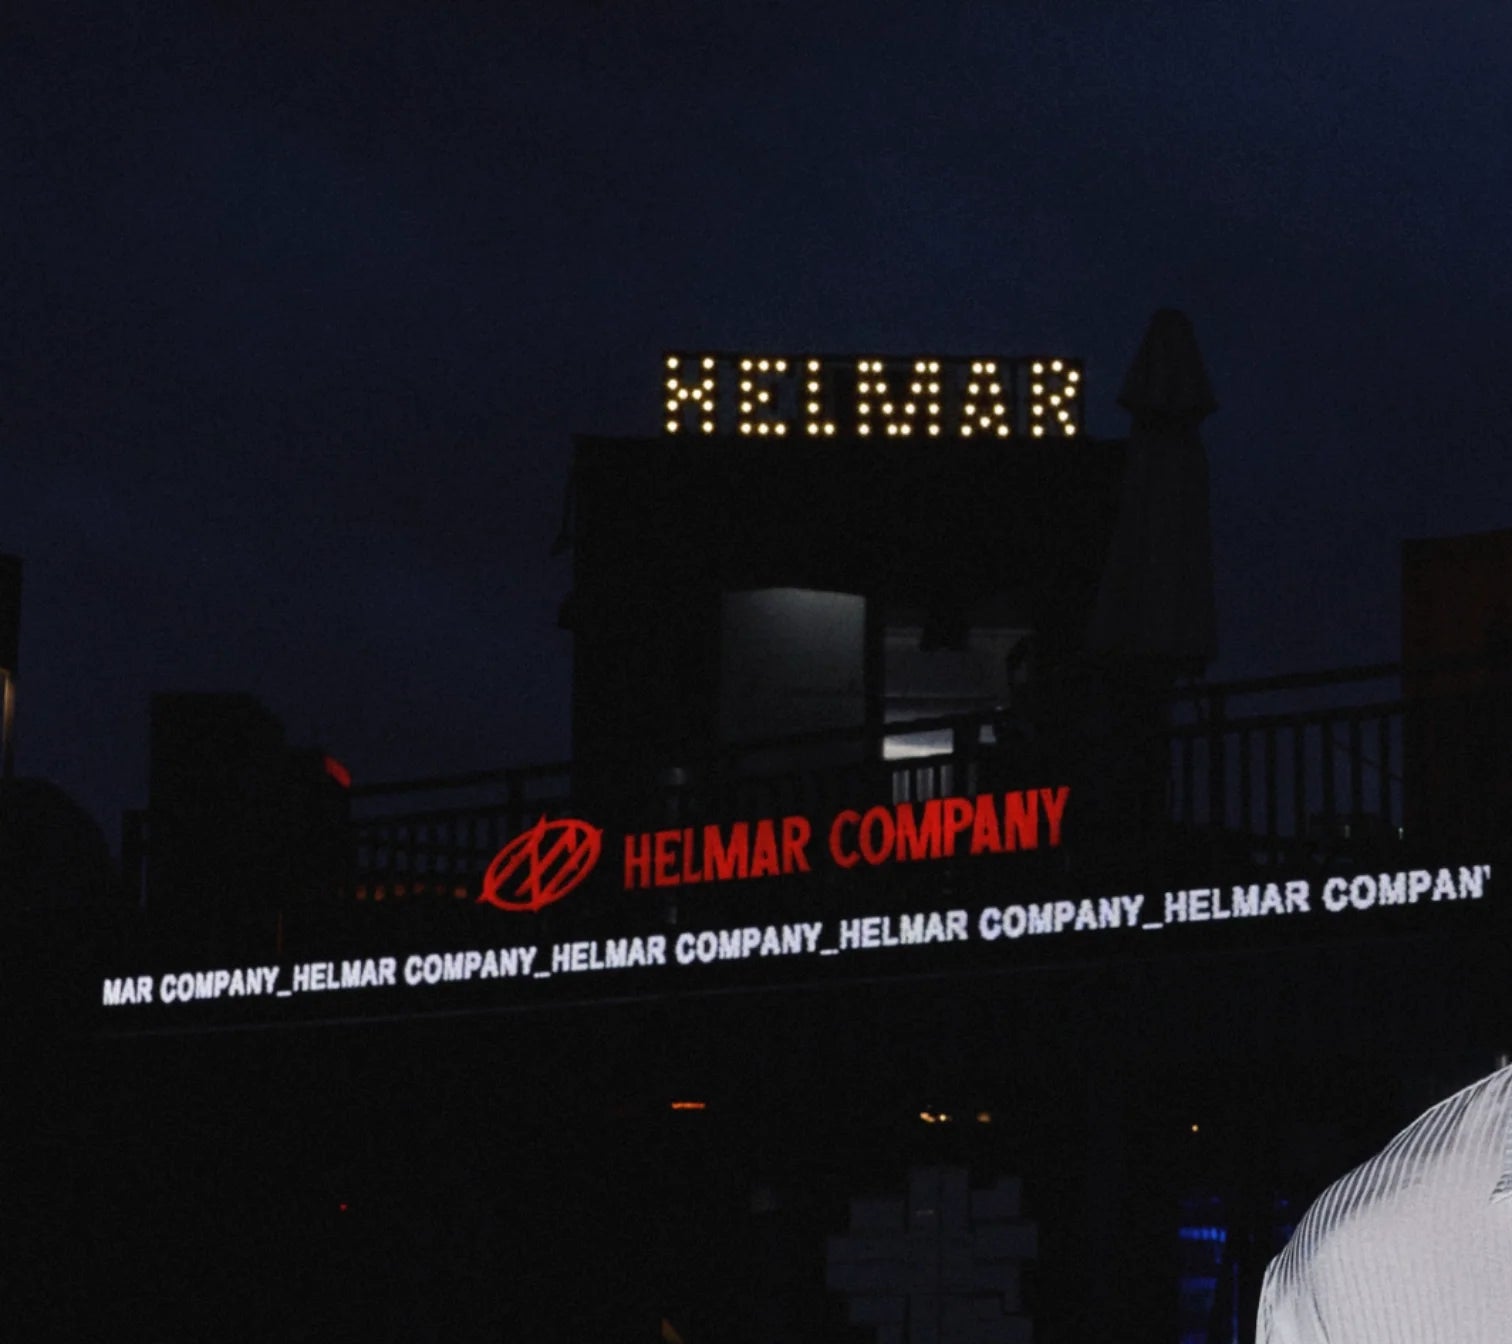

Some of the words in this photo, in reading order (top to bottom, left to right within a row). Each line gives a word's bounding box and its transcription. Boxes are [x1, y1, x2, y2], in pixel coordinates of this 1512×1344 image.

[666, 357, 1080, 437] HELMAR
[624, 815, 812, 889] HELMAR
[828, 786, 1070, 868] COMPANY
[102, 975, 154, 1006] MAR
[1321, 864, 1491, 912] COMPAN
